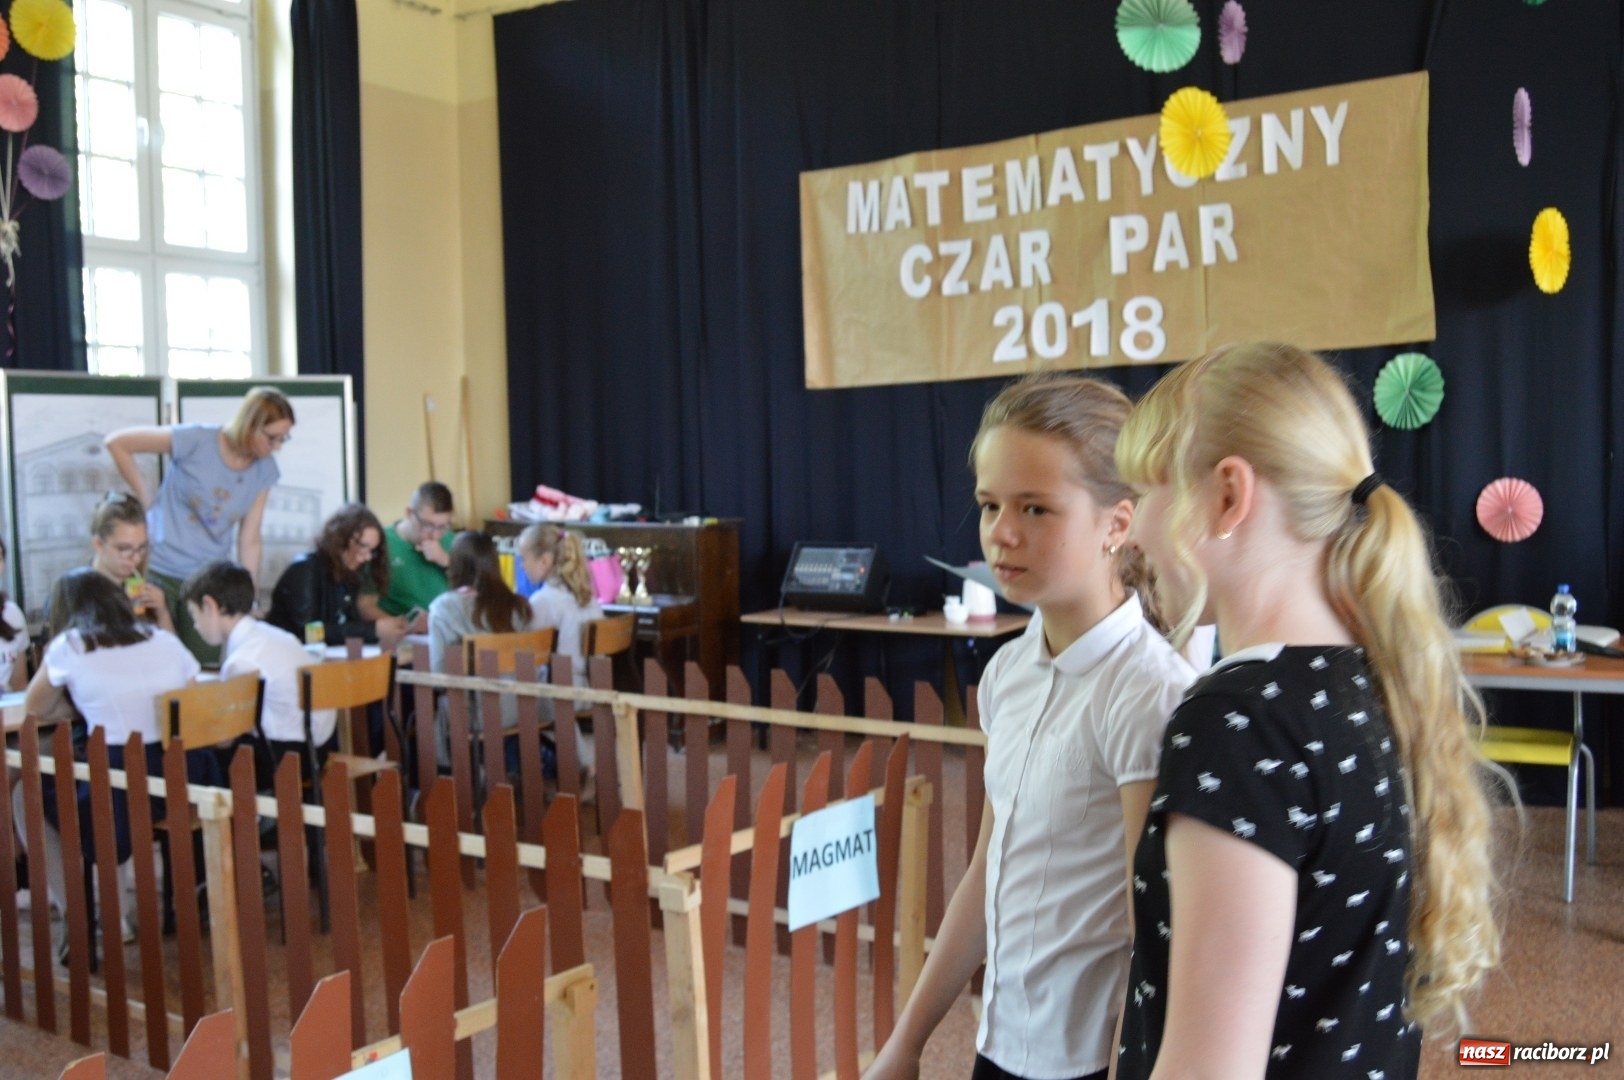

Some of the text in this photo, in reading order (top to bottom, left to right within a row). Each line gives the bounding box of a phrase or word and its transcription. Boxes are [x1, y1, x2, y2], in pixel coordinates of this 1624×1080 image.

[900, 203, 1238, 298] CZAR PAR
[993, 296, 1166, 362] 2018
[792, 829, 873, 880] MAGMAT
